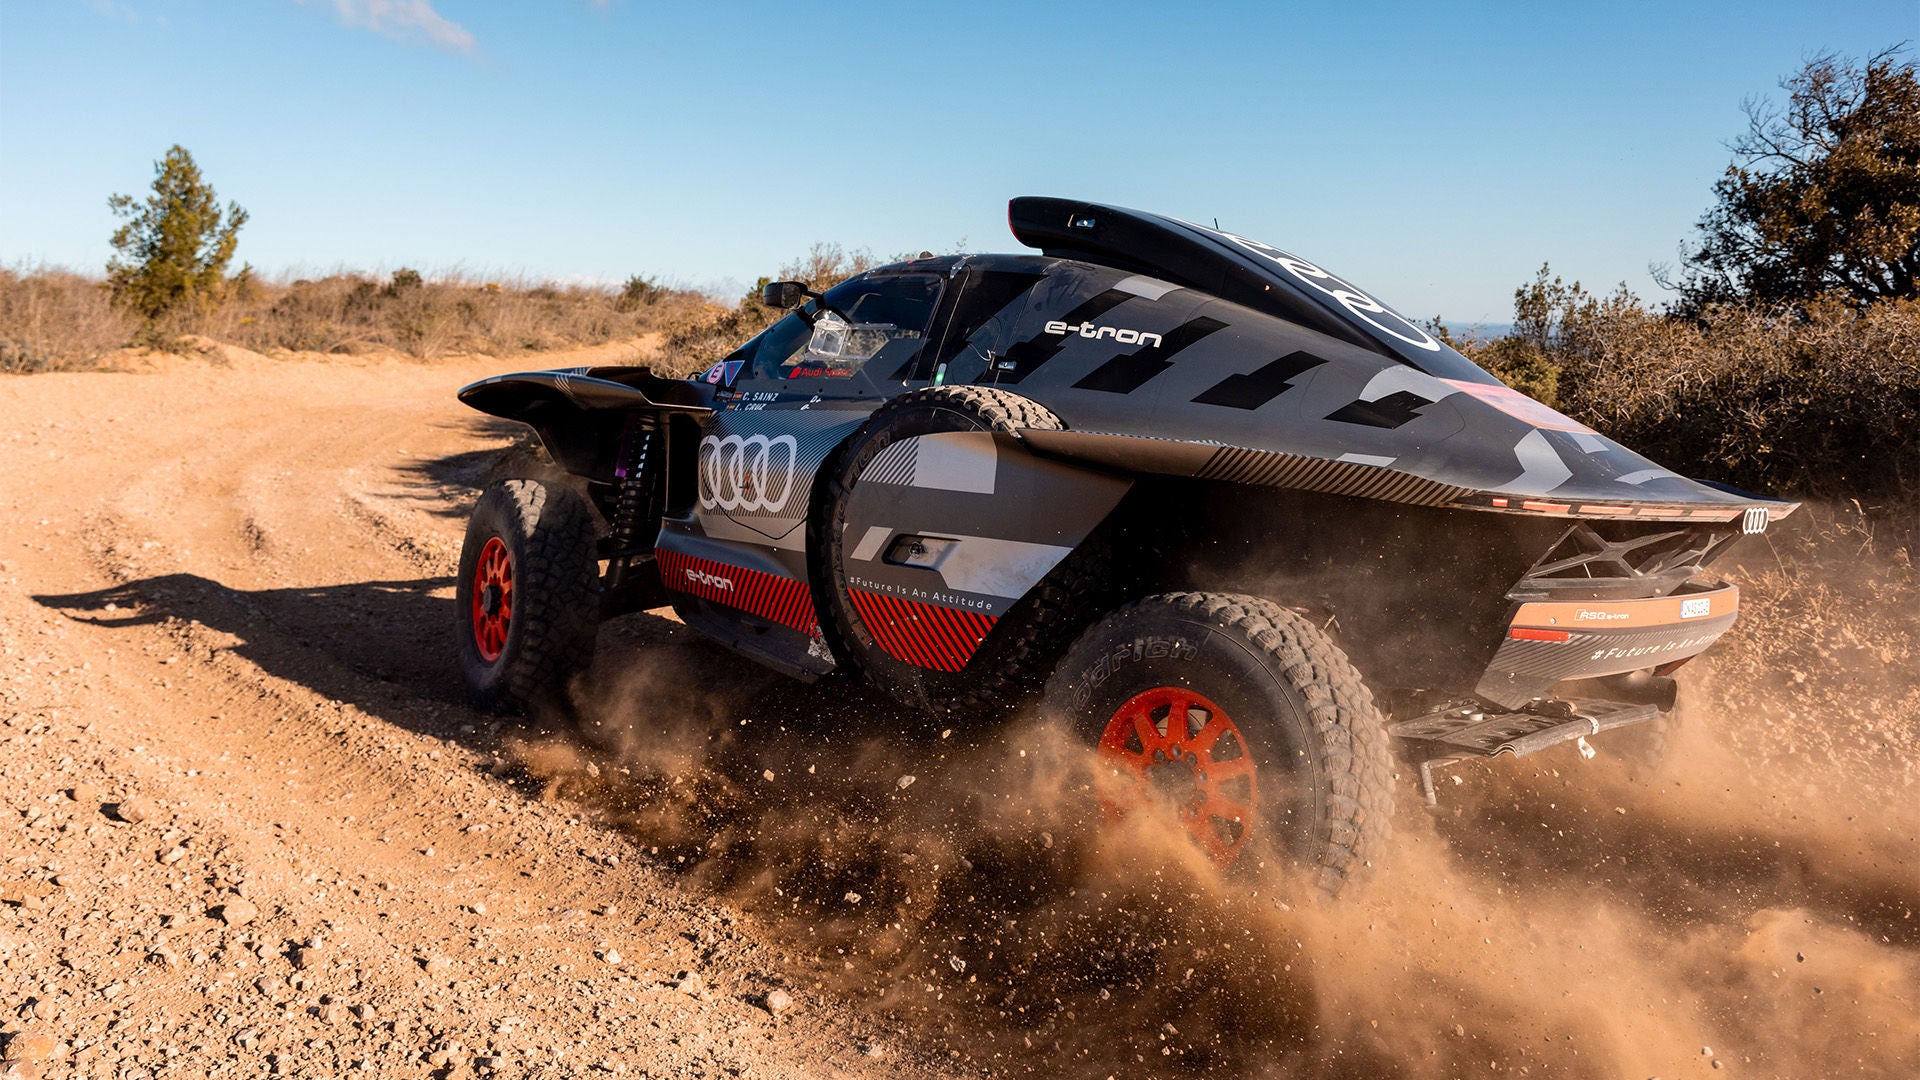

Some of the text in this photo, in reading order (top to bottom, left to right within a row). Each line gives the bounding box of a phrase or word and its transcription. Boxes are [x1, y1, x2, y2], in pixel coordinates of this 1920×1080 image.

[1044, 320, 1163, 348] e-tron
[801, 367, 823, 377] Audi
[744, 403, 767, 411] CRUZ
[752, 392, 780, 402] SAINZ
[686, 568, 734, 592] e-tron
[849, 576, 993, 611] #Future Is An Attitude
[1591, 644, 1659, 661] #Future
[1661, 640, 1677, 652] Is
